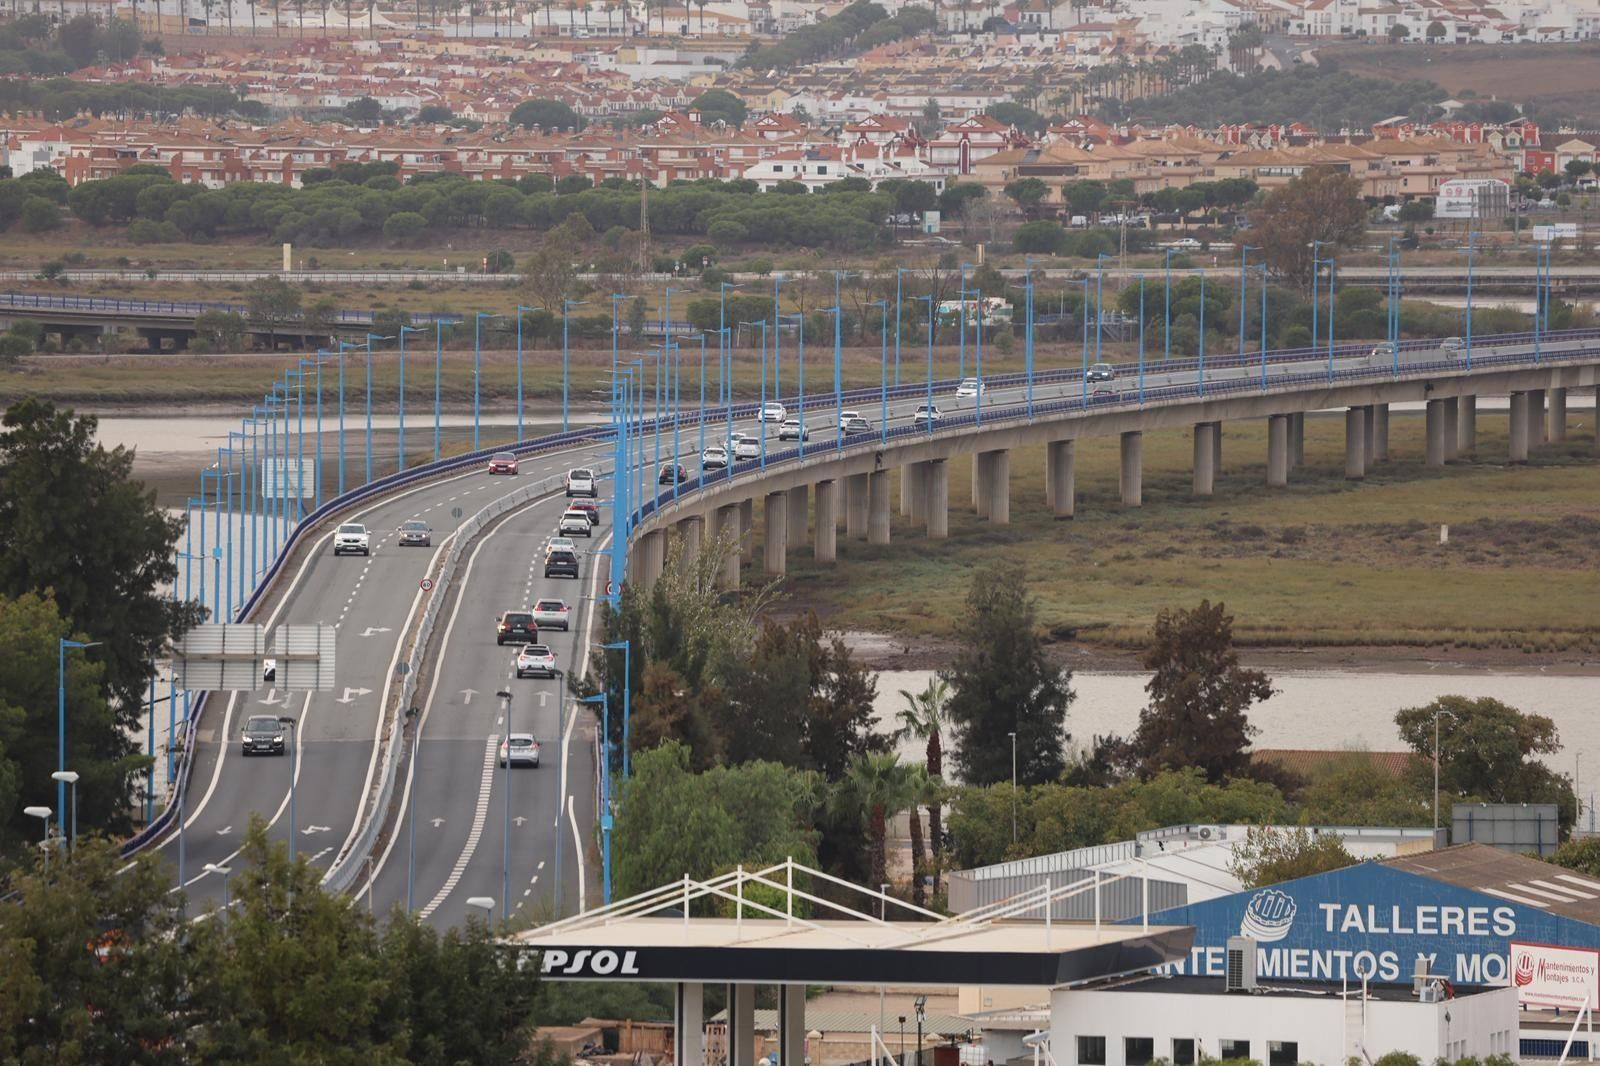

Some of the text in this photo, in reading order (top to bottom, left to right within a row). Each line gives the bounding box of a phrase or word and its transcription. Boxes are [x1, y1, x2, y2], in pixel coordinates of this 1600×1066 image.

[1319, 903, 1516, 936] TALLERES
[1456, 953, 1511, 982] MO
[1537, 957, 1590, 976] Mantenimientos
